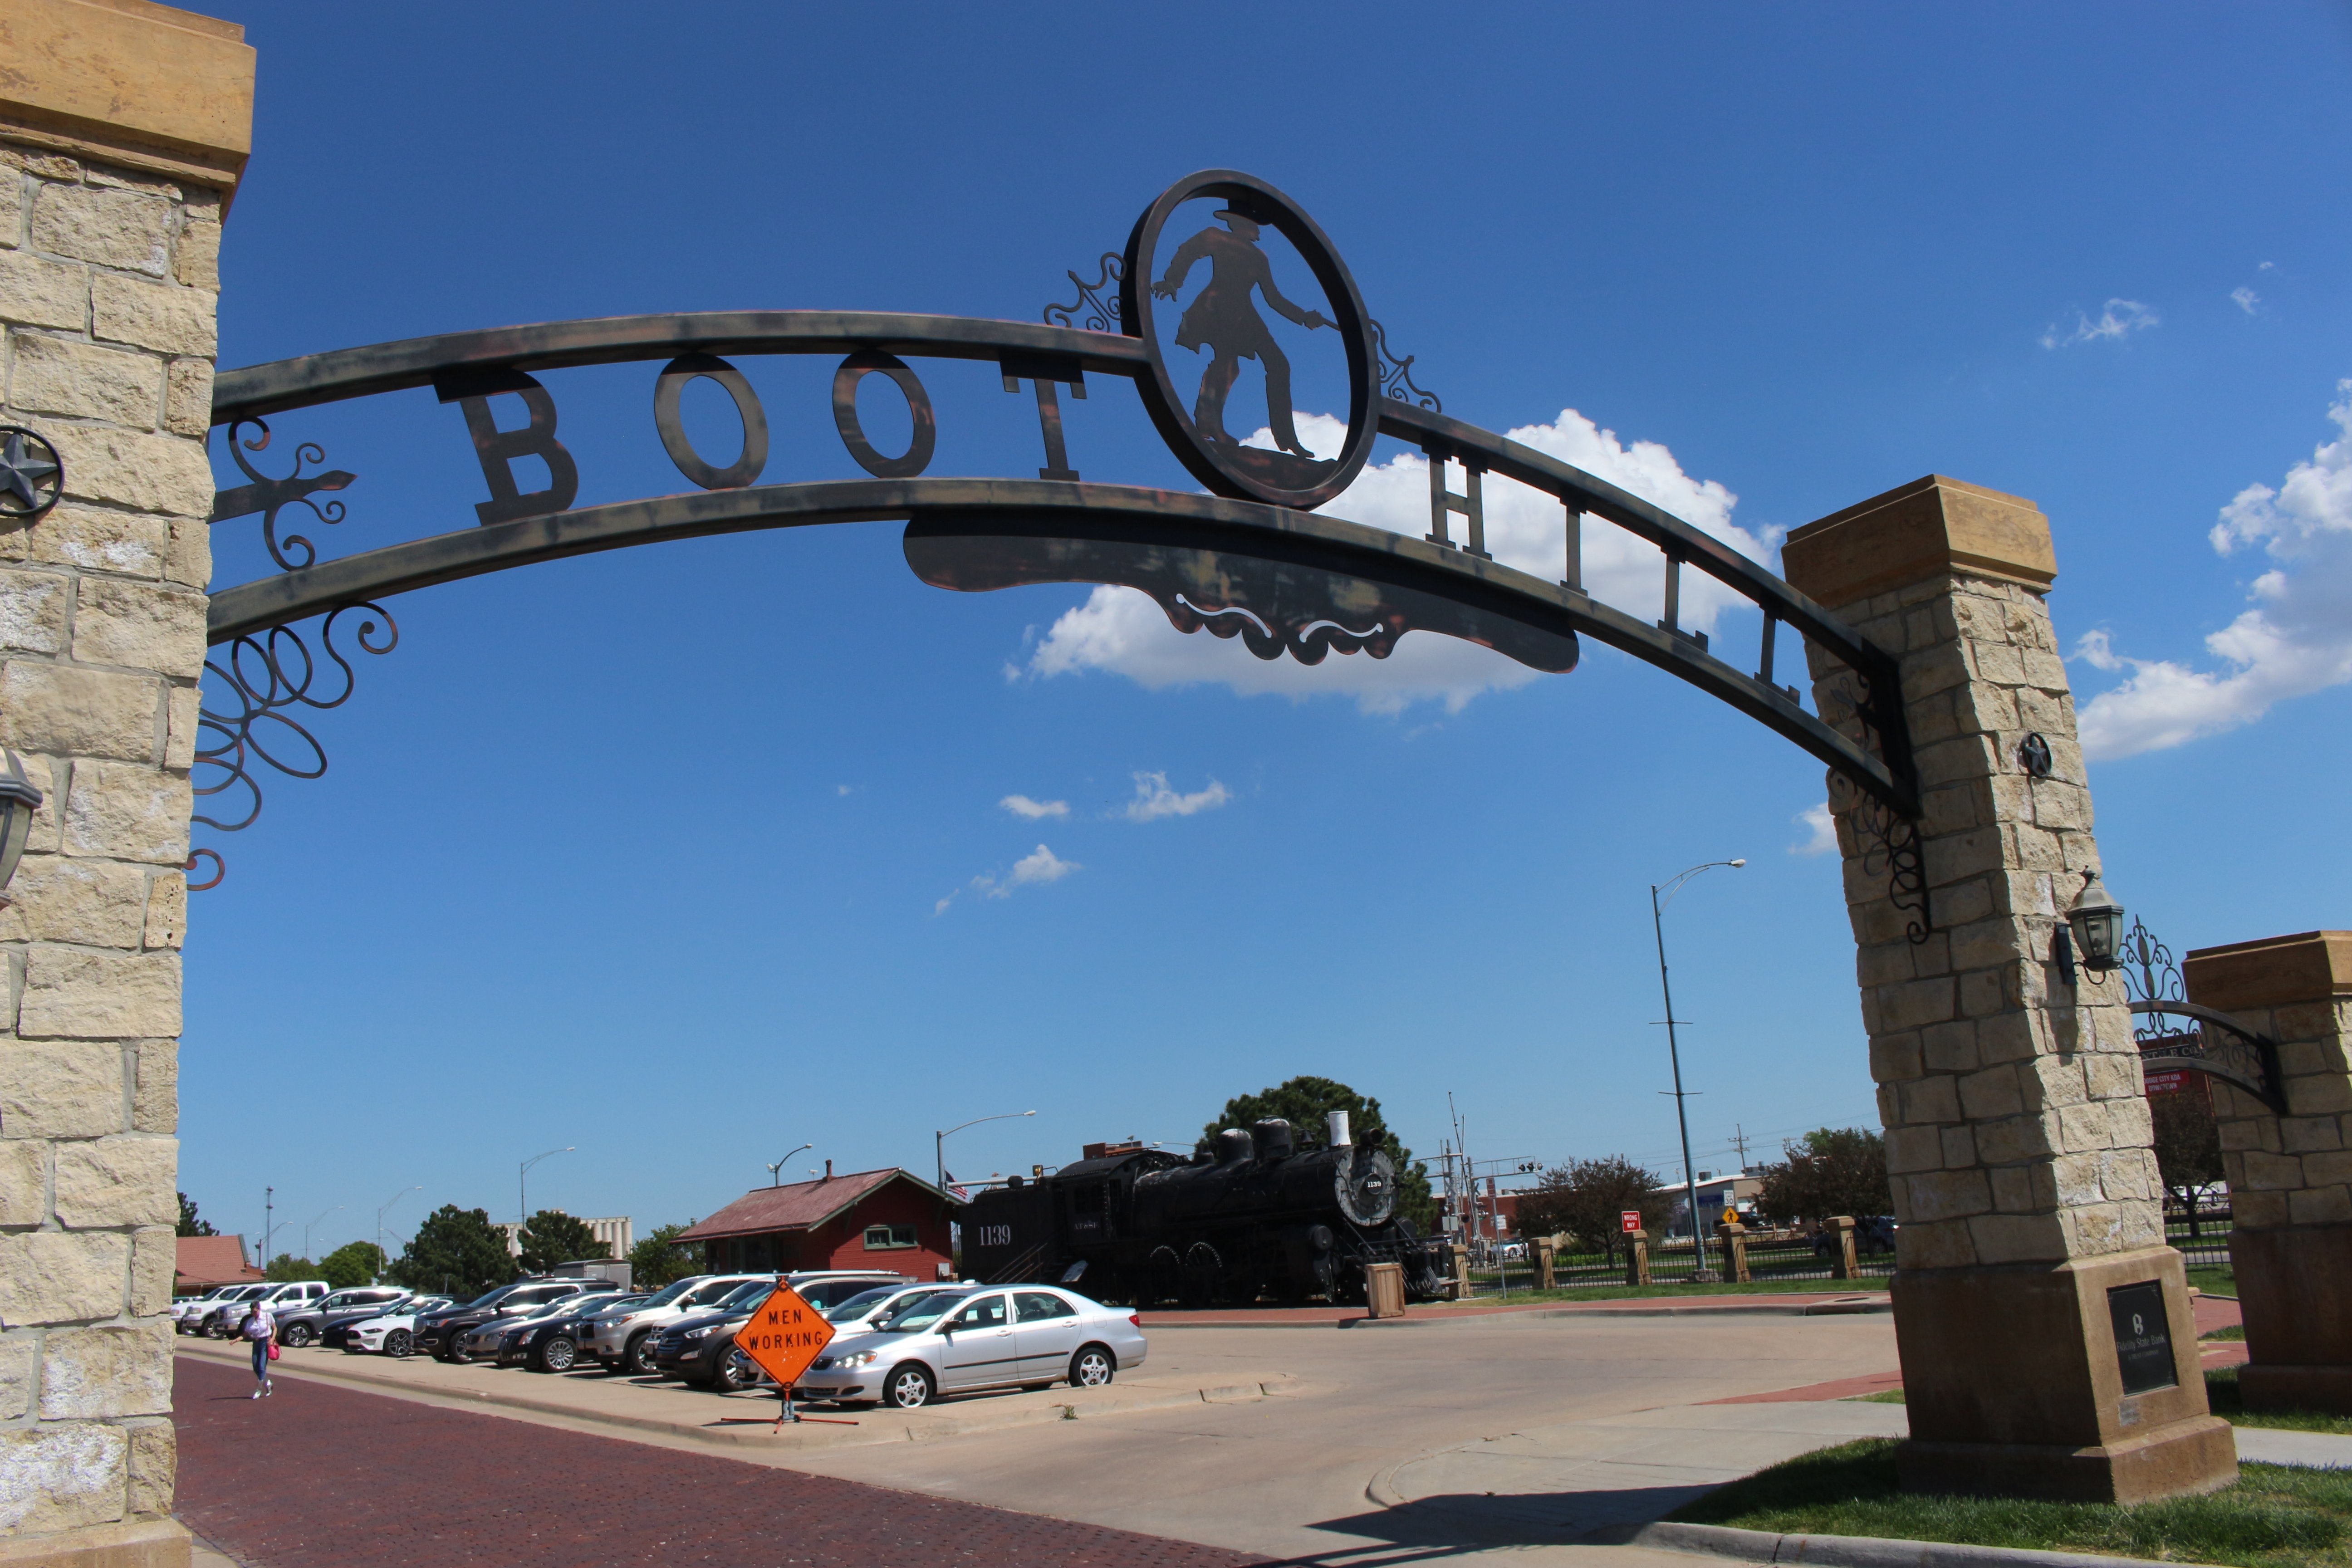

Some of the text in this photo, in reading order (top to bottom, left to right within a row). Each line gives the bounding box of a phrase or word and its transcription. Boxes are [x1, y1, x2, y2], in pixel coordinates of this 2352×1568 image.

[432, 350, 1800, 706] BOOT HILL
[980, 1225, 1011, 1246] 1139
[768, 1309, 802, 1325] MEN
[749, 1331, 823, 1351] WORKING
[2117, 1334, 2165, 1352] Fidelity State Bank
